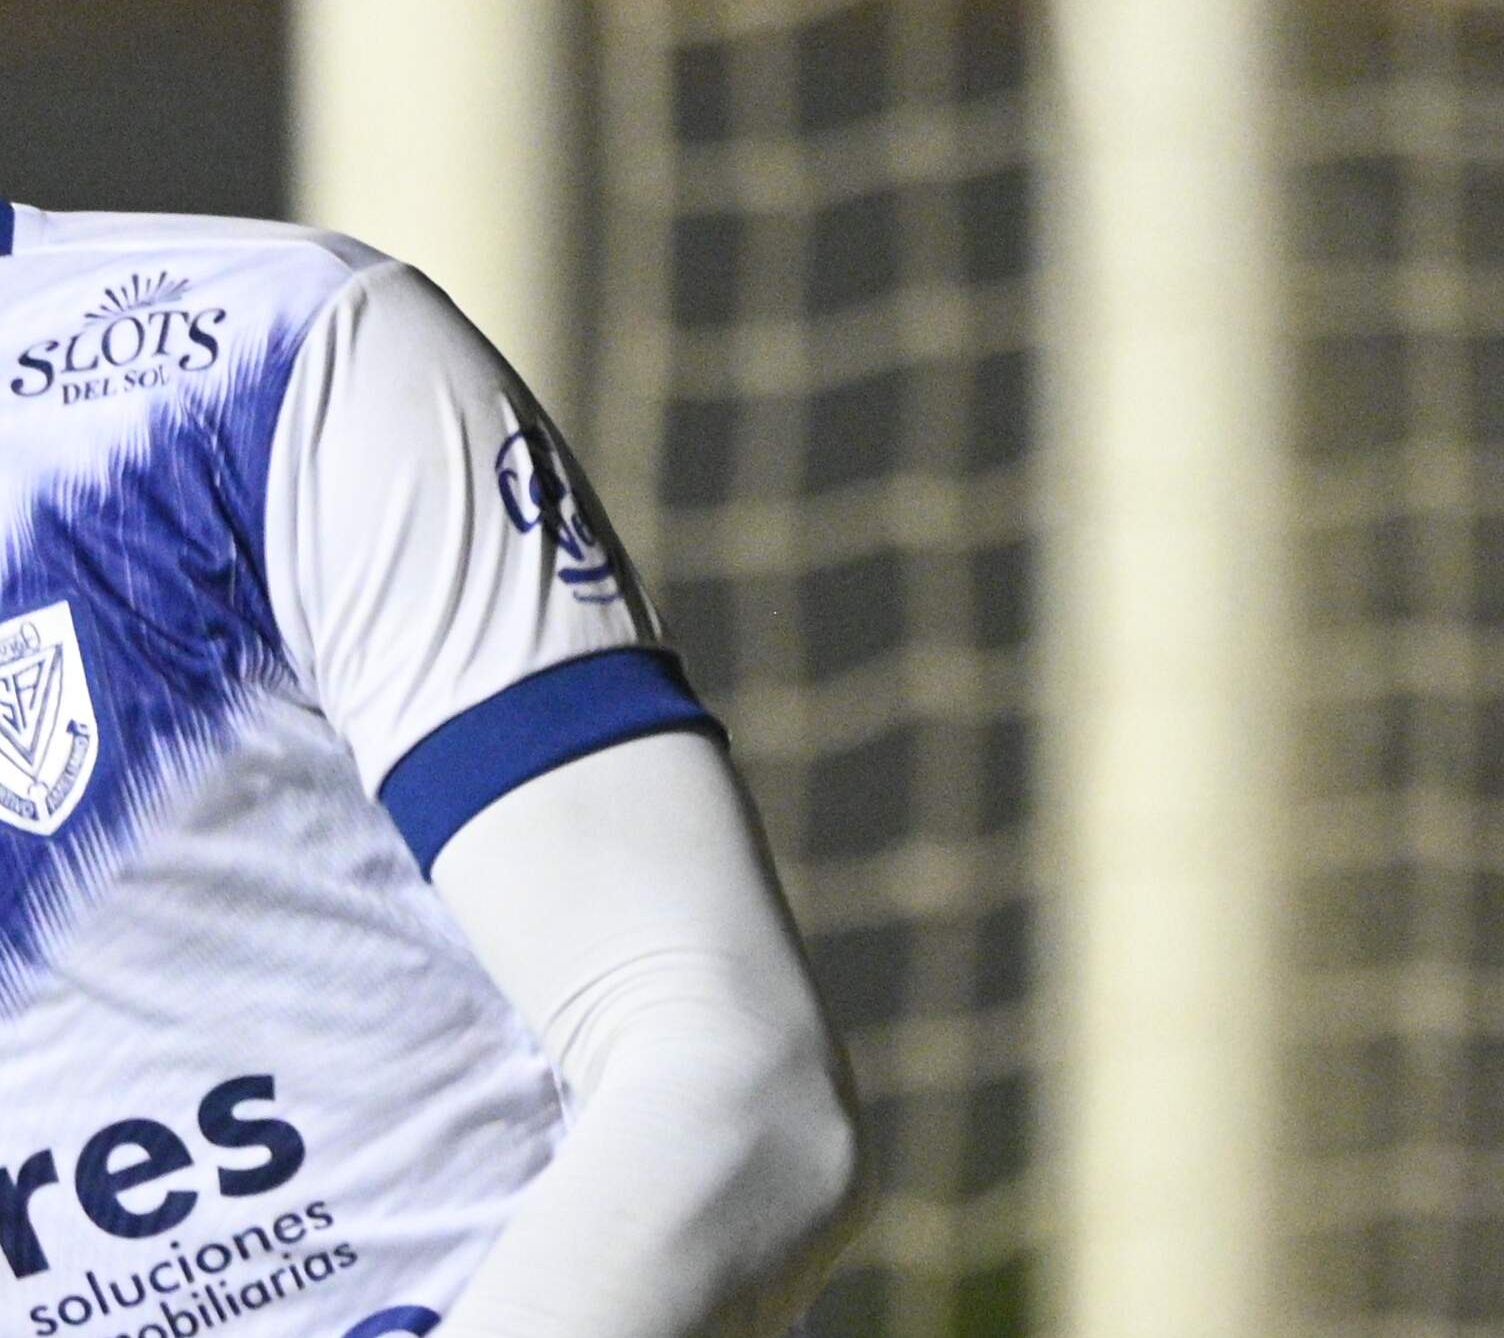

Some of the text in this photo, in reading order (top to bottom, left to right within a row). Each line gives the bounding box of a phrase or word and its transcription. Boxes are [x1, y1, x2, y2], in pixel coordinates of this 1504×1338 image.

[10, 308, 226, 396] SLOTS
[62, 377, 115, 405] DEL
[29, 1198, 333, 1338] soluciones
